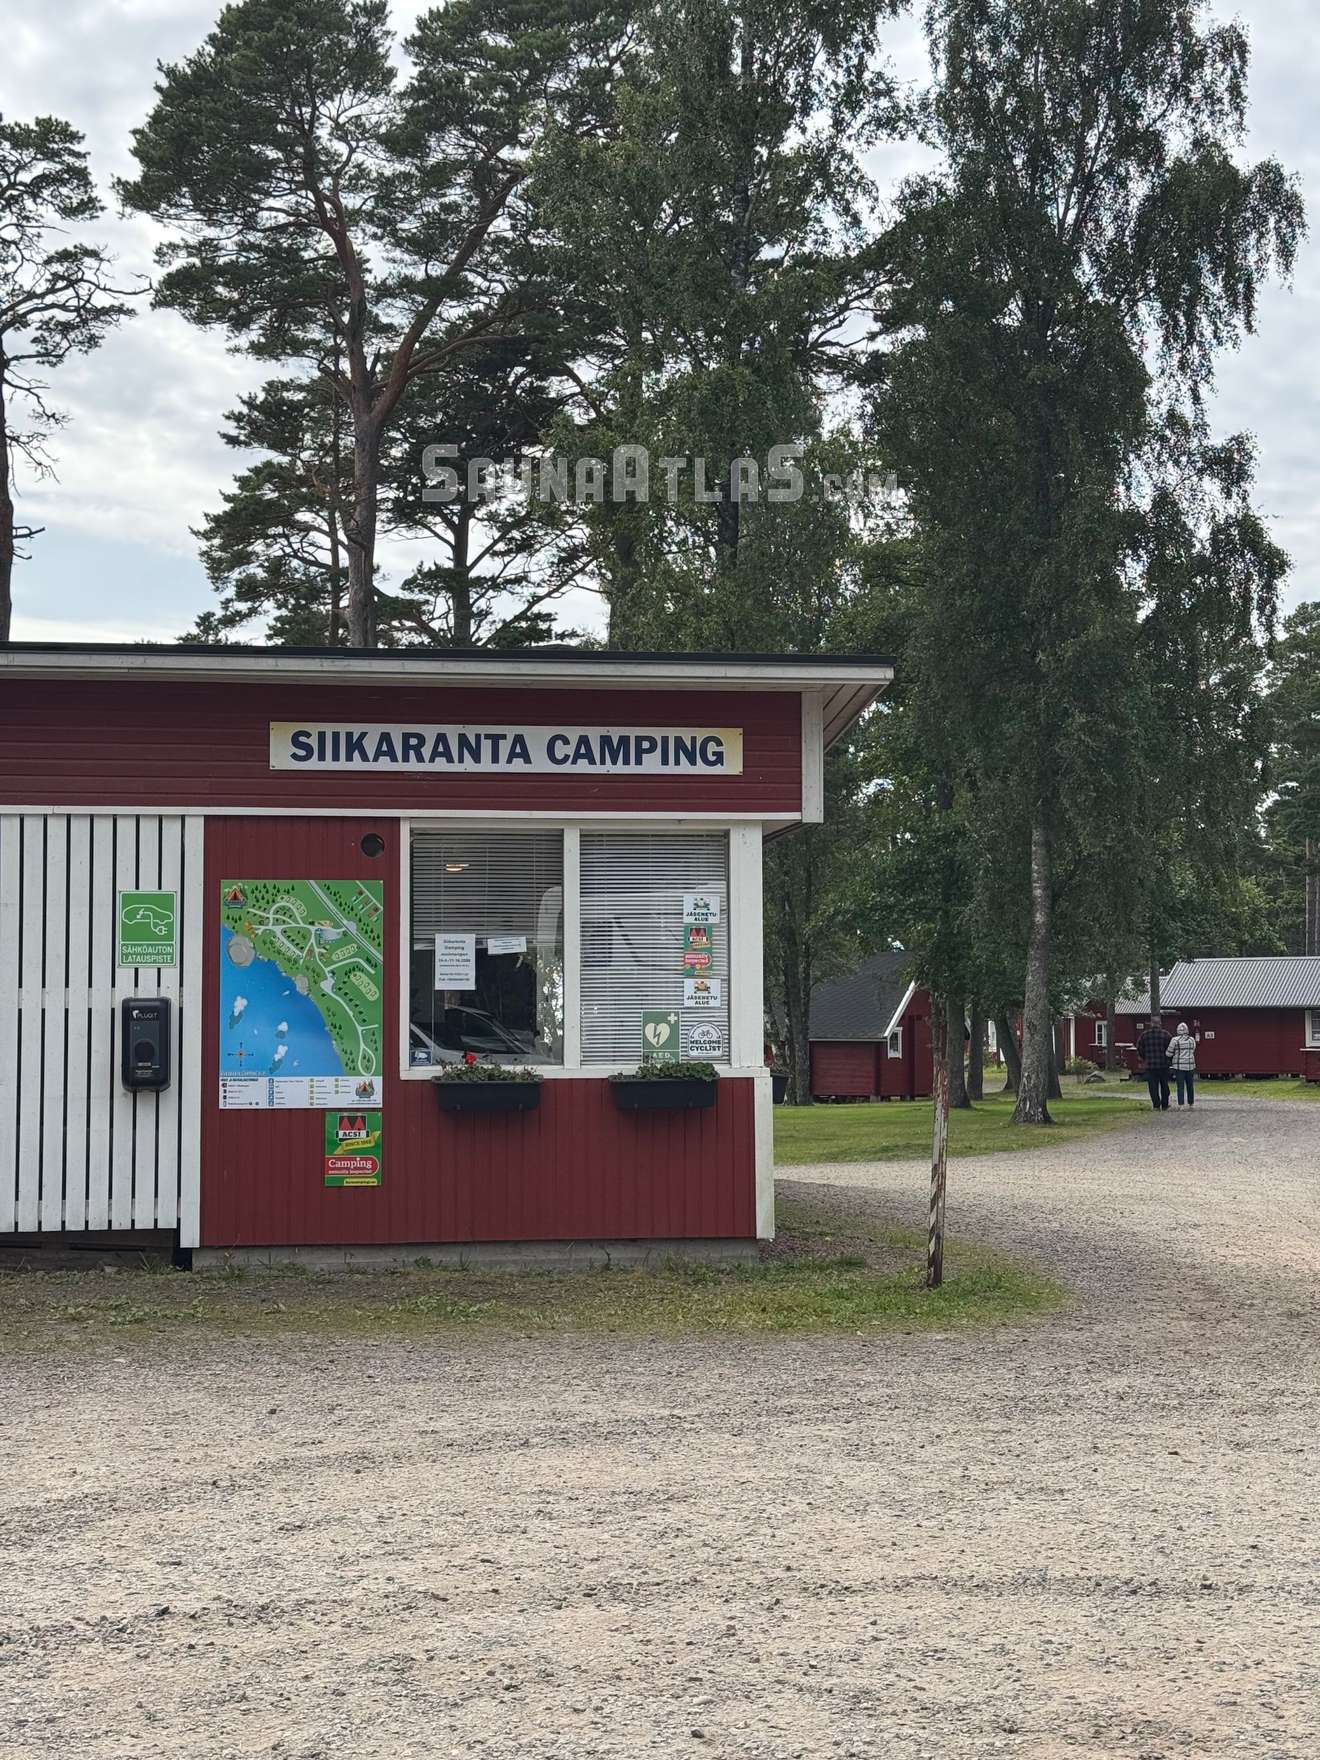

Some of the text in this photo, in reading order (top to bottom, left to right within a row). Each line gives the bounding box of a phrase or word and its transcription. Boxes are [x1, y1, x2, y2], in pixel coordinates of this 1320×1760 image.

[290, 730, 725, 767] SIIKARANTA CAMPING
[121, 944, 173, 954] SÄHKÖAUTON
[122, 954, 173, 963] LATAUSPISTE
[328, 1157, 373, 1169] Camping
